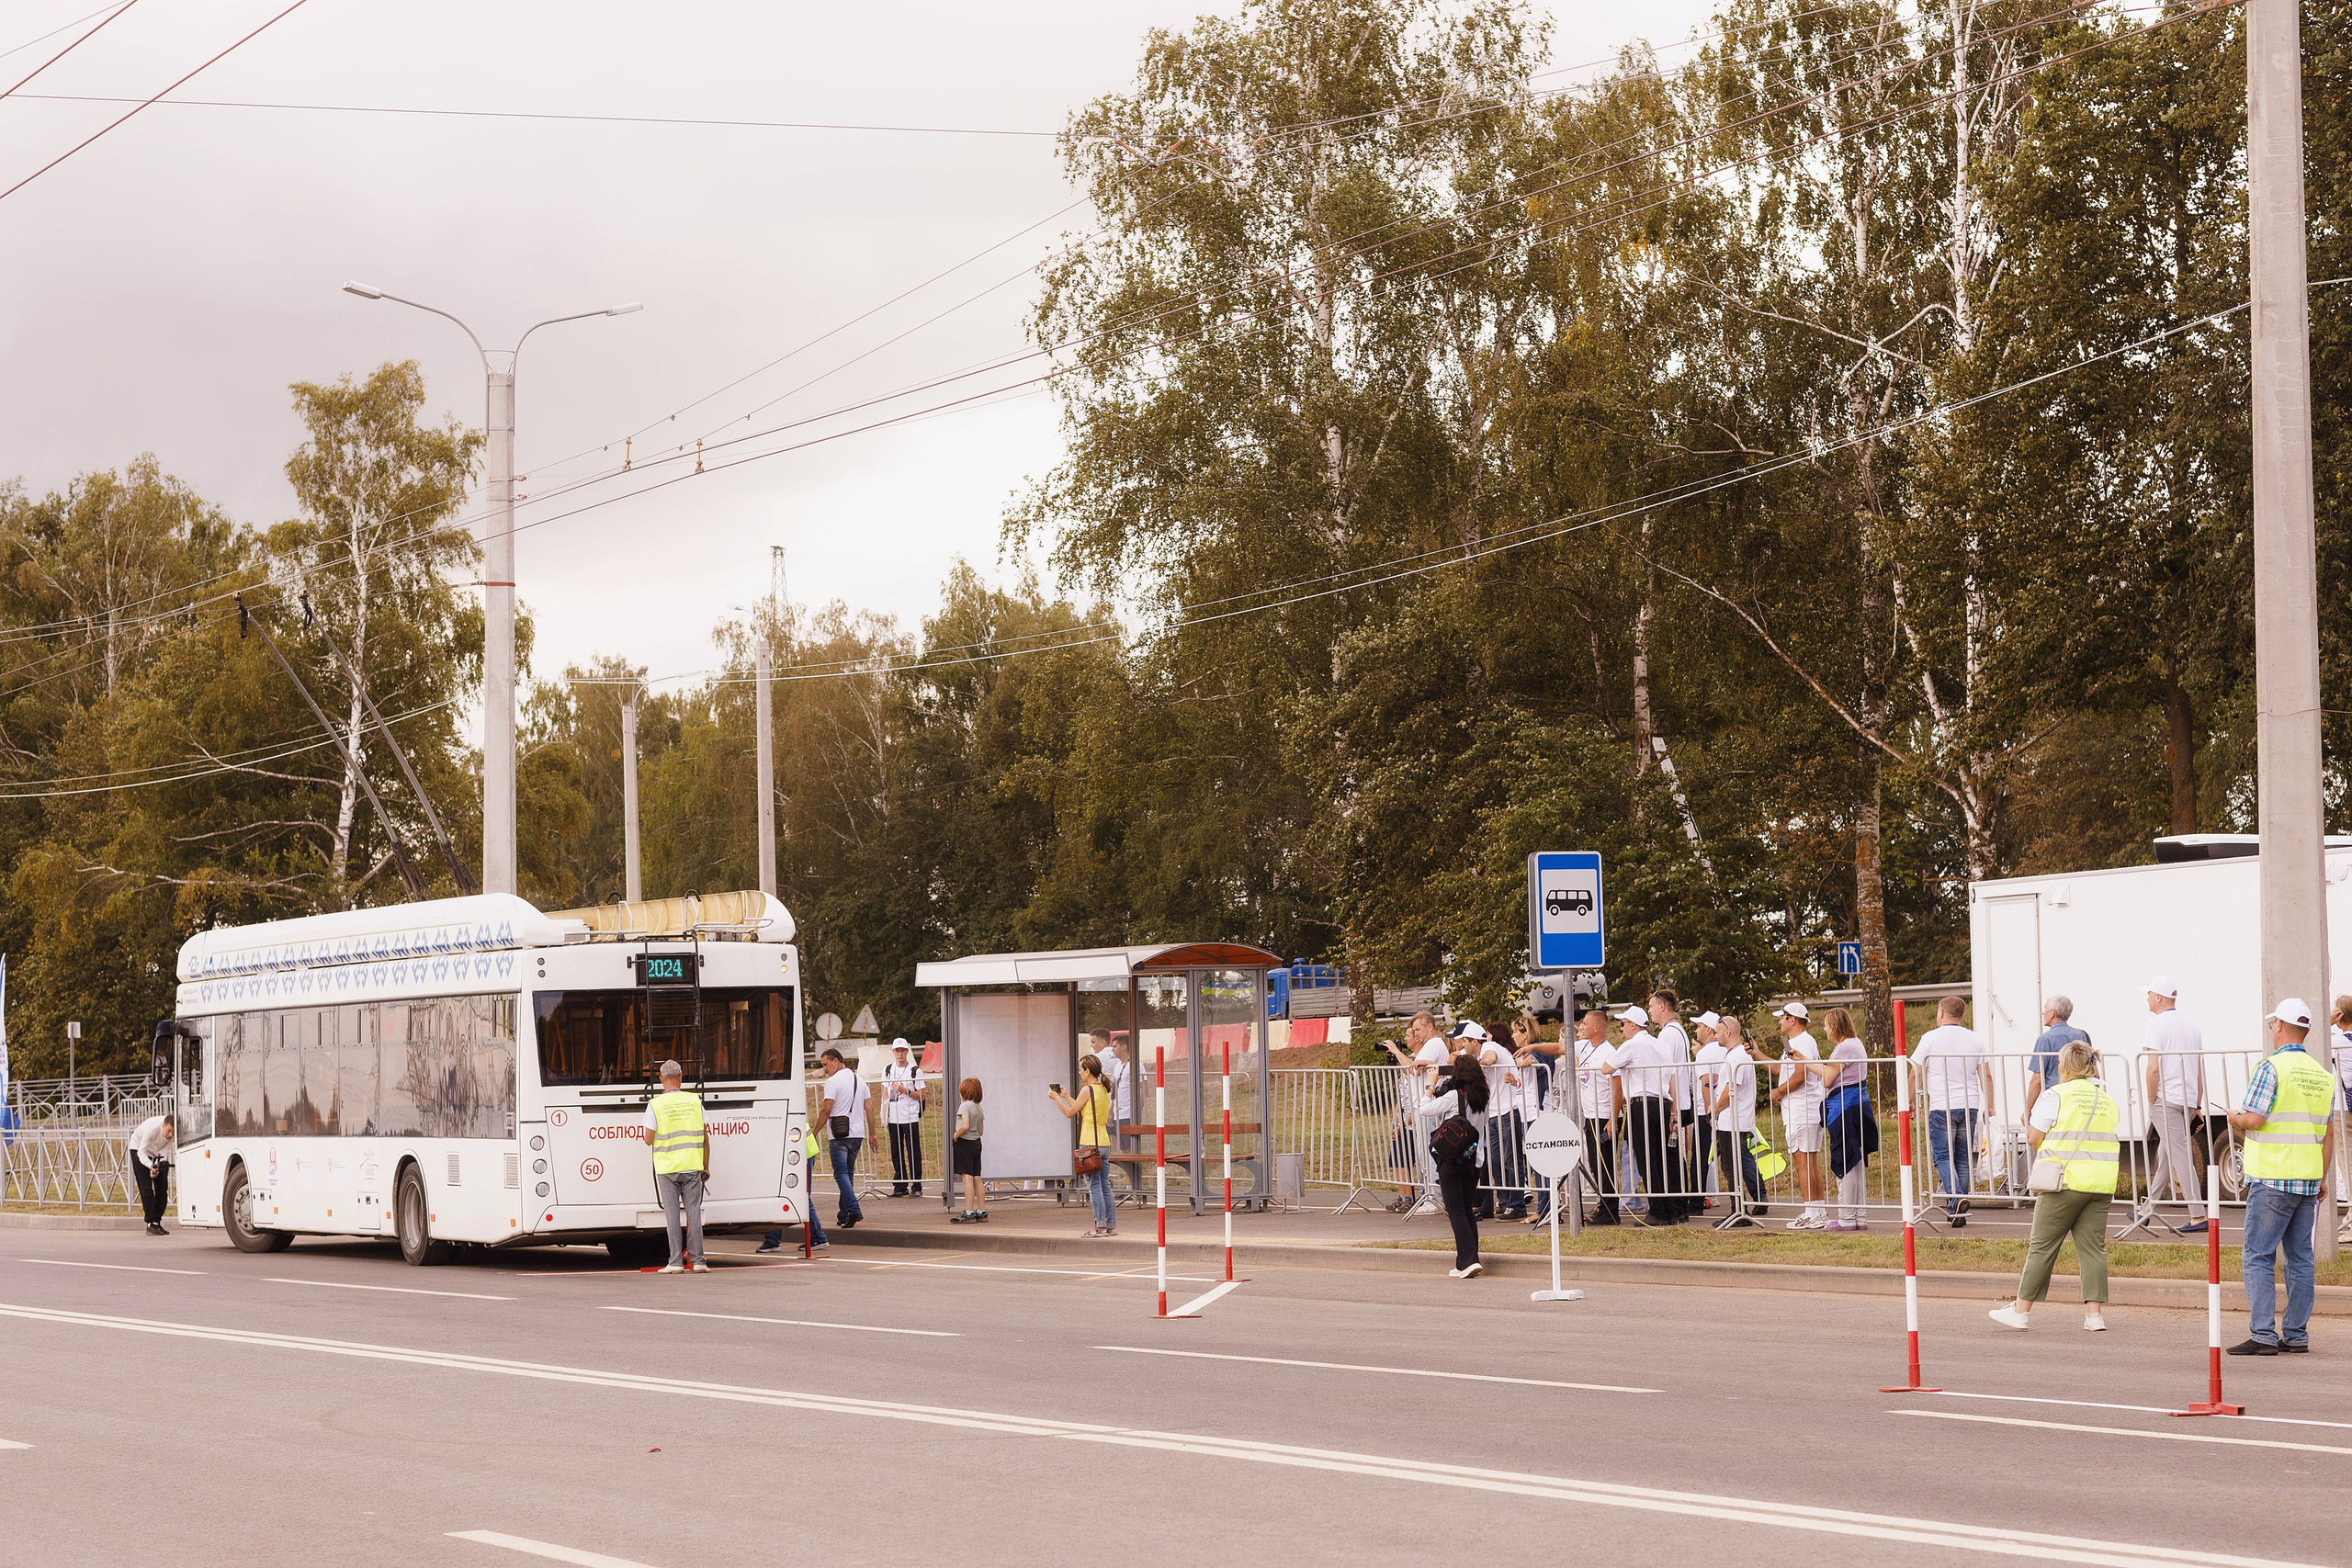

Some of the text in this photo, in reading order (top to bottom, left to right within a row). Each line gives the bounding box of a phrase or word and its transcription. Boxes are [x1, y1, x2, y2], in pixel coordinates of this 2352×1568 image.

[648, 959, 683, 977] 2024
[555, 1112, 561, 1124] 1
[589, 1122, 750, 1141] СОБЛЮД АНЦИЮ
[1525, 1140, 1580, 1150] ОСТАНОВКА
[585, 1164, 600, 1176] 50
